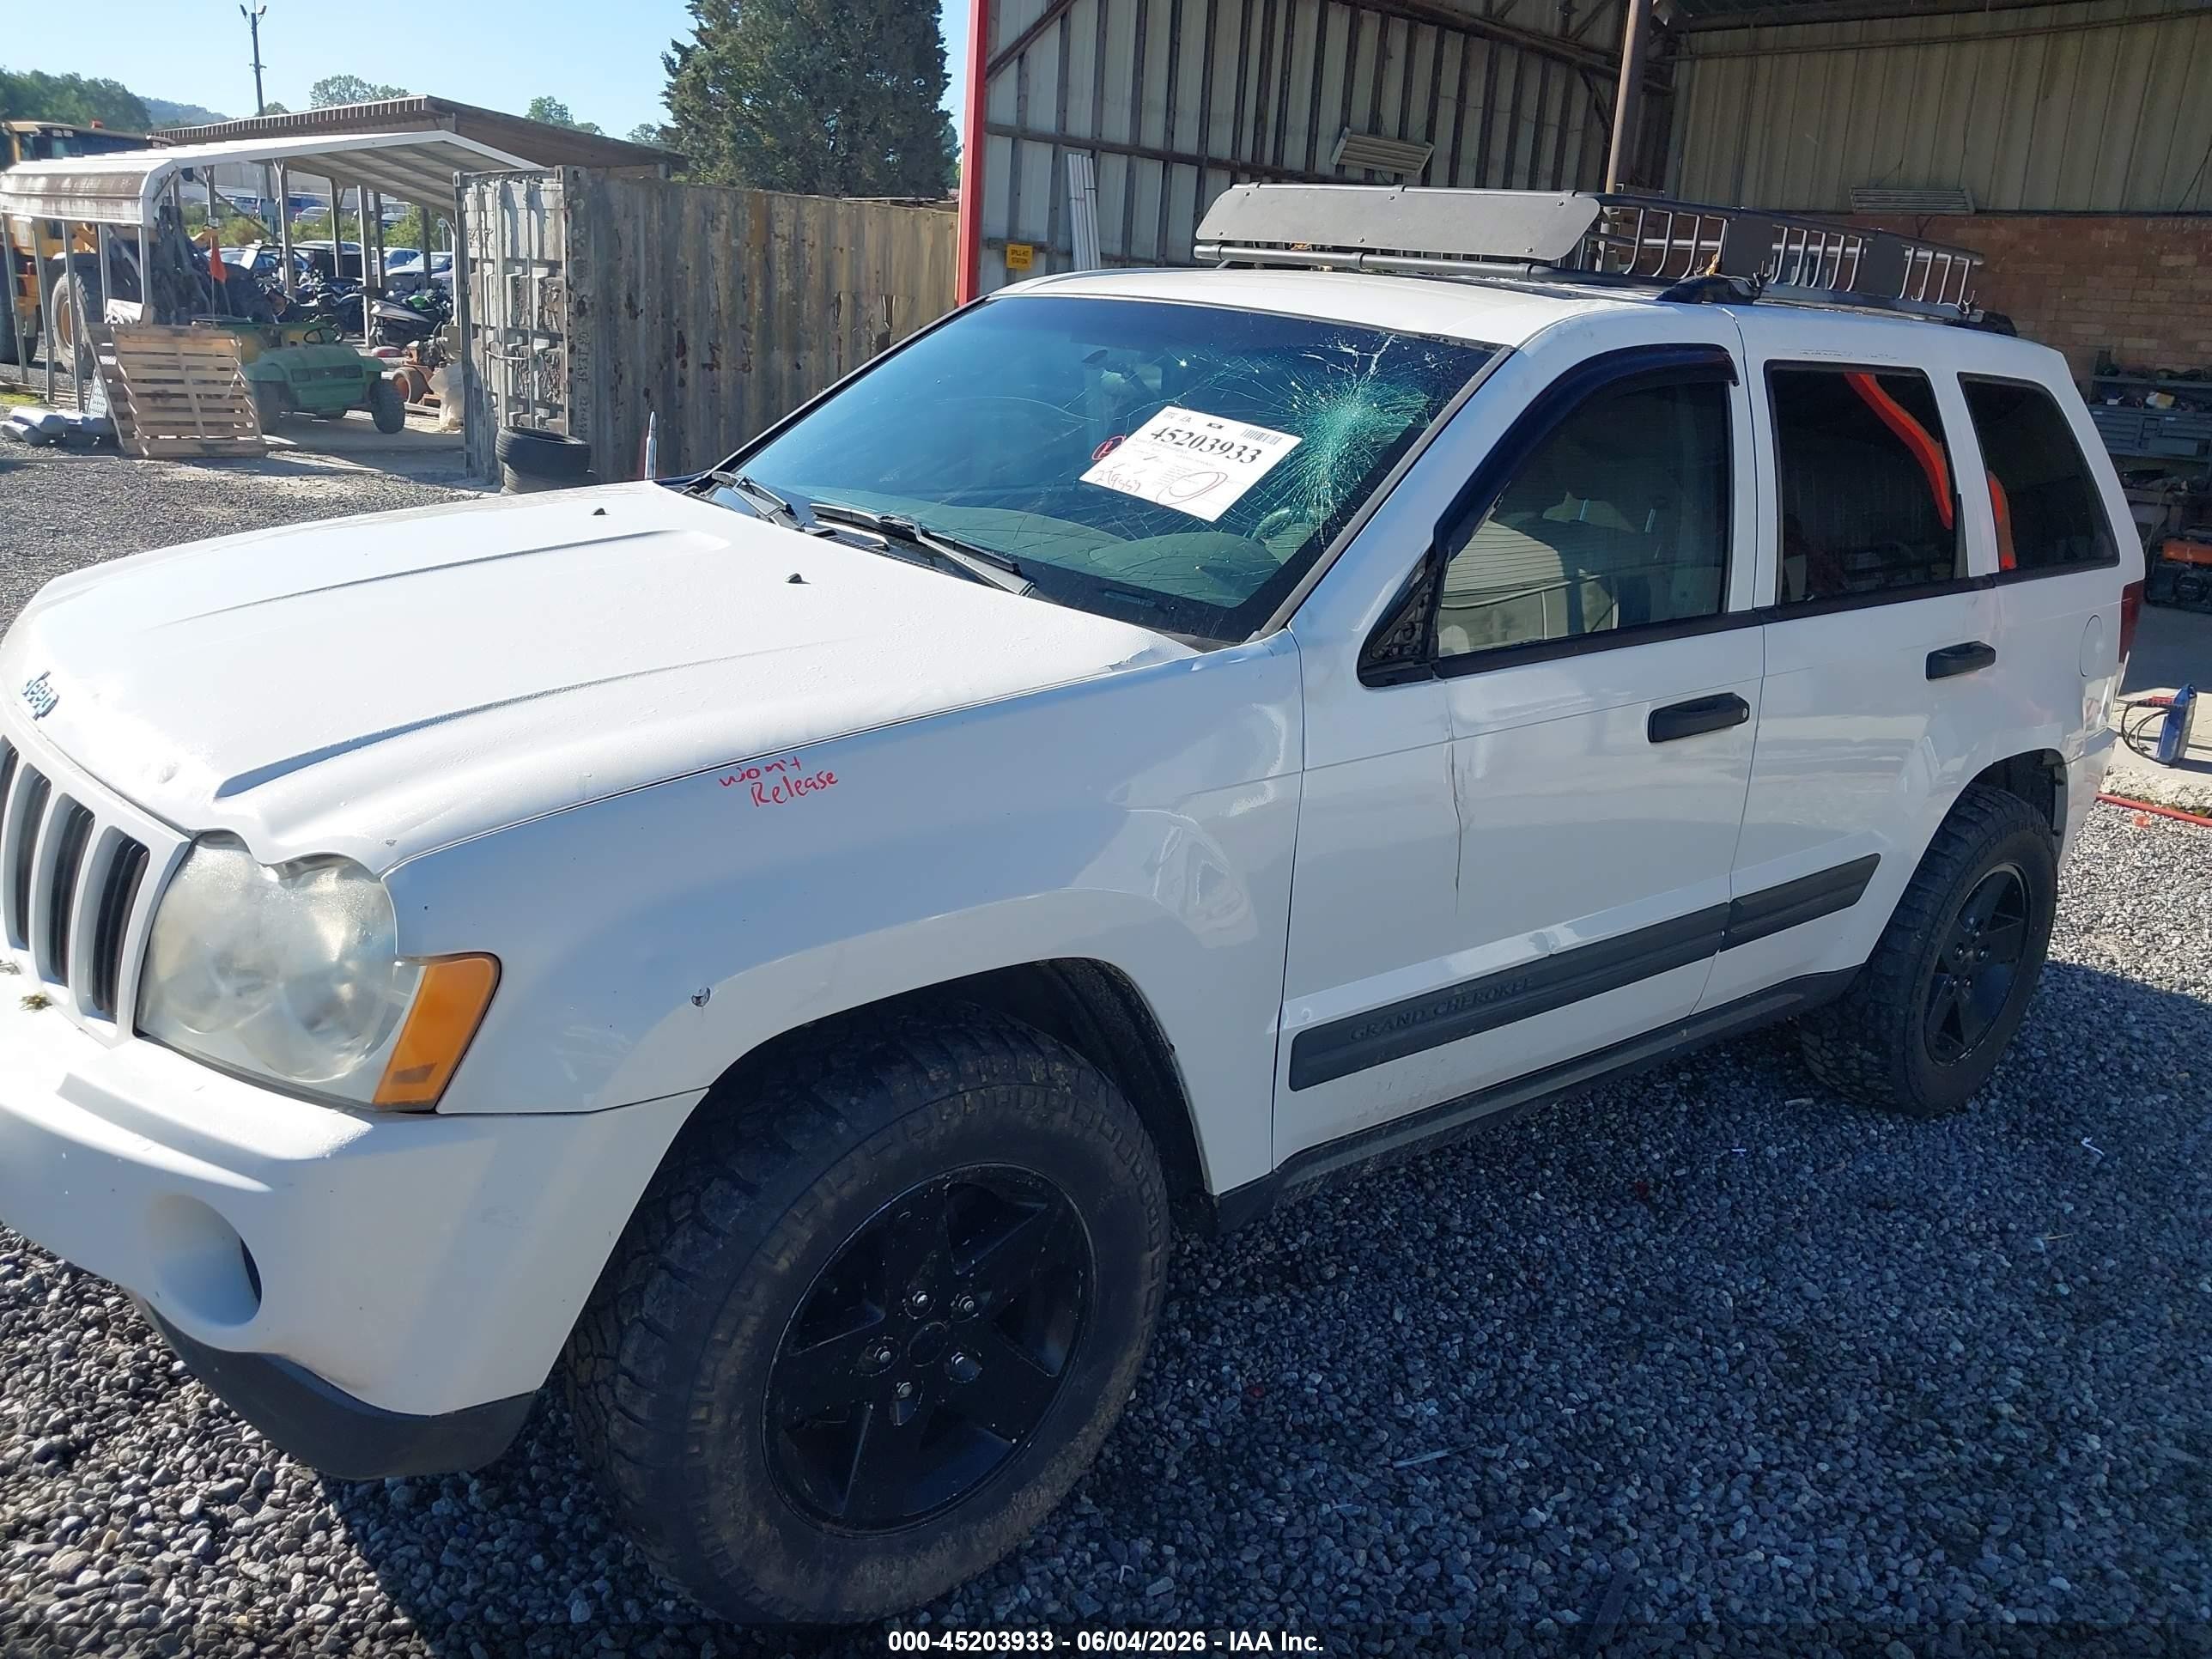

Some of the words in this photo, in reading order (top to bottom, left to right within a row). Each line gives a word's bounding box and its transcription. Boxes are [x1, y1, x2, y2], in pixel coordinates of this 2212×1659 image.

[1151, 427, 1262, 464] 45203933
[21, 670, 60, 721] Jeep
[750, 770, 839, 807] Release
[1350, 1009, 1428, 1041] GRAND
[1433, 977, 1534, 1016] CHEROKEE
